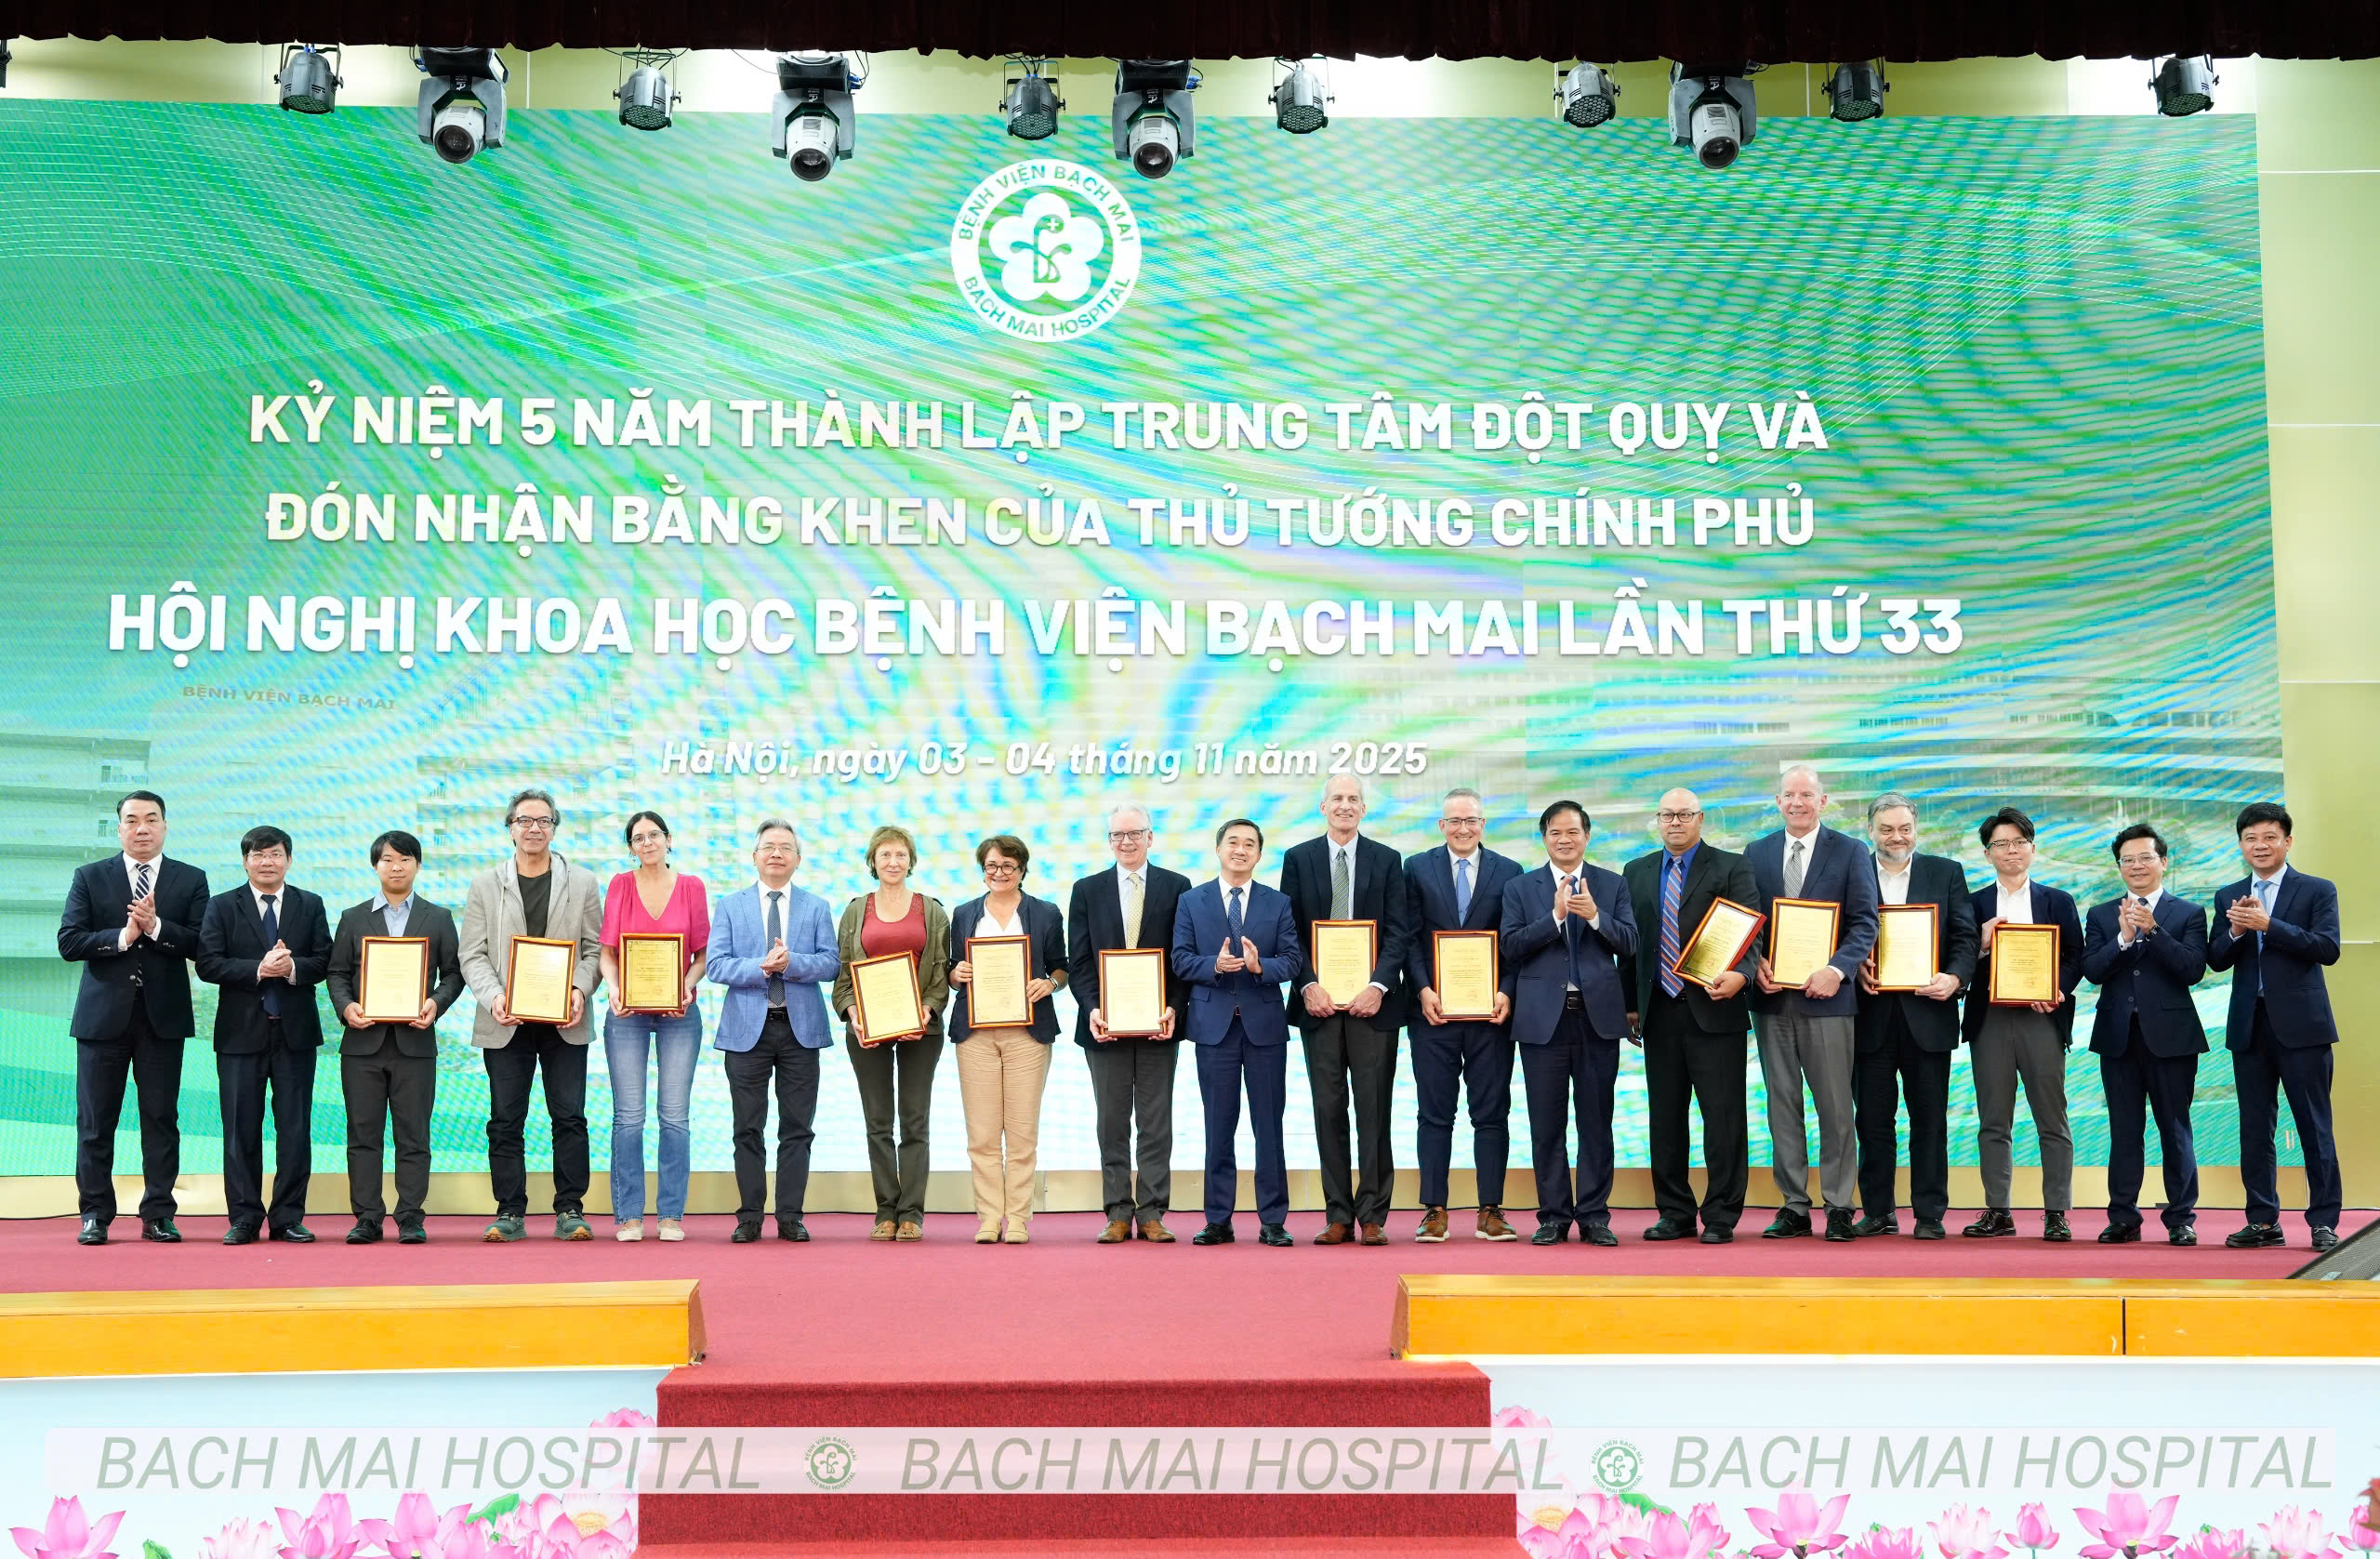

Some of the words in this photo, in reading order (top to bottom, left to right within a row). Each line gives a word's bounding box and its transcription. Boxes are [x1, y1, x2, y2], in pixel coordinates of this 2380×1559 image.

[959, 188, 995, 240] BỆNH
[997, 165, 1046, 189] VIỆN
[1053, 165, 1110, 202] BẠCH
[1107, 202, 1134, 242] MAI
[964, 275, 1006, 323] BACH
[1007, 315, 1044, 337] MAI
[1051, 277, 1130, 337] HOSPITAL
[250, 379, 334, 443] KỶ
[352, 385, 503, 459] NIỆM
[521, 398, 556, 446] 5
[574, 387, 712, 447] NĂM
[729, 389, 943, 448] THÀNH
[961, 390, 1085, 464] LẬP
[1102, 402, 1309, 450] TRUNG
[1325, 390, 1452, 450] TÂM
[1471, 391, 1593, 464] ĐỘT
[1608, 403, 1730, 464] QUỴ
[1747, 390, 1829, 450] VÀ
[265, 481, 396, 542] ĐÓN
[415, 482, 594, 557] NHẬN
[611, 473, 783, 546] BẰNG
[800, 496, 967, 546] KHEN
[985, 482, 1111, 546] CỦA
[1127, 482, 1250, 547] THỦ
[1265, 486, 1474, 547] TƯỚNG
[1490, 486, 1676, 547] CHÍNH
[1692, 482, 1814, 547] PHỦ
[108, 580, 227, 669] HỘI
[246, 595, 416, 669] NGHỊ
[435, 597, 633, 654] KHOA
[653, 598, 795, 672] HỌC
[815, 585, 1005, 672] BỆNH
[1025, 586, 1186, 673] VIỆN
[1206, 600, 1395, 673] BẠCH
[1412, 600, 1540, 656] MAI
[1559, 576, 1704, 656] LẦN
[1722, 585, 1869, 655] THỨ
[1880, 598, 1964, 655] 33
[182, 684, 236, 700] BỆNH
[243, 689, 291, 705] VIỆN
[298, 694, 350, 707] BẠCH
[356, 697, 395, 709] MAI
[661, 741, 716, 775] Hà
[722, 741, 800, 784] Nội,
[811, 741, 908, 784] ngày
[917, 742, 968, 775] 03
[1005, 742, 1056, 775] 04
[1068, 743, 1182, 784] tháng
[1194, 743, 1228, 775] 11
[1233, 743, 1319, 775] năm
[1328, 743, 1430, 775] 2025
